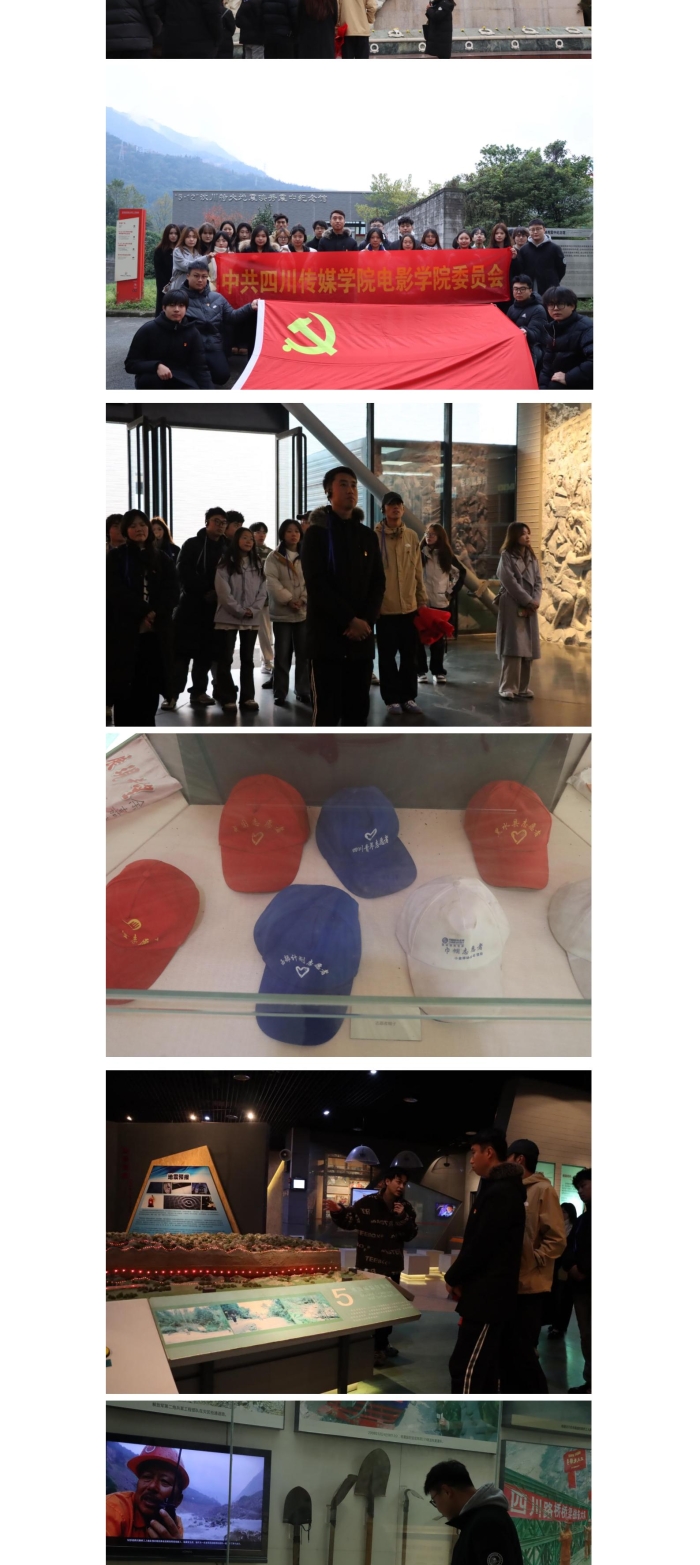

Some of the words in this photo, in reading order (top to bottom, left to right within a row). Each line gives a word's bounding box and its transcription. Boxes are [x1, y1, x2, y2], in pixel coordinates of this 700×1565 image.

[221, 263, 504, 295] 中共四川传媒学院电影学院委员会
[331, 1287, 354, 1307] 5
